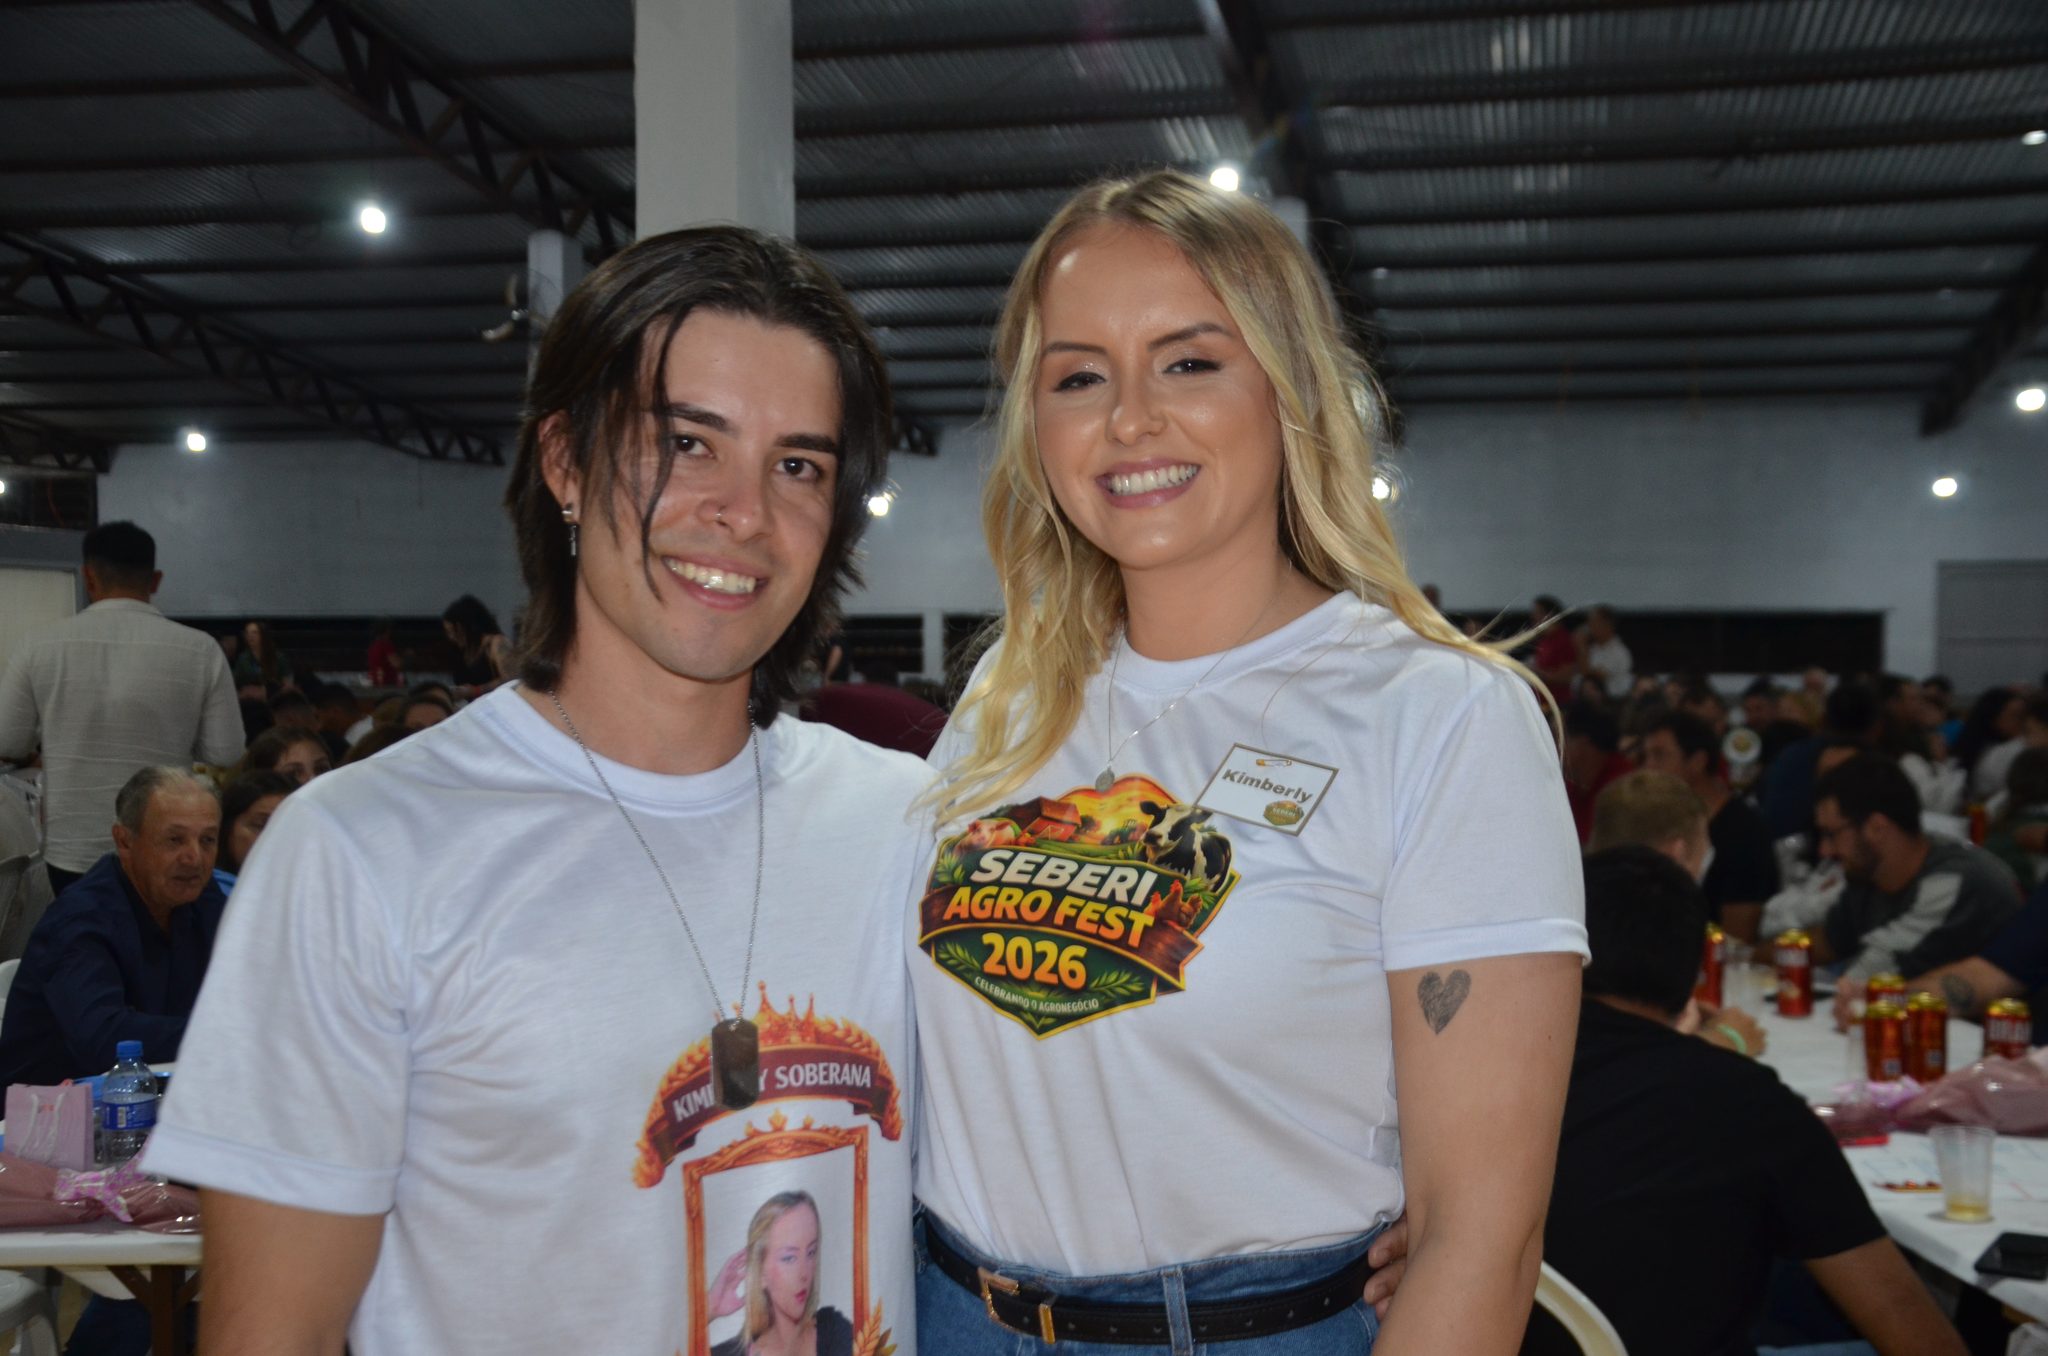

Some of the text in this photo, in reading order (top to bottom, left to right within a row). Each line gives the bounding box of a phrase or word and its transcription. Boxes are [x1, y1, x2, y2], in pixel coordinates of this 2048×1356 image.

[1222, 769, 1313, 803] Kimberly
[970, 850, 1158, 906] SEBERI
[943, 886, 1155, 948] AGRO FEST
[981, 933, 1087, 990] 2026
[975, 976, 1100, 1013] CELEBRANDO O AGRONEGÓCIO
[673, 1062, 871, 1122] KIMY SOBERANA
